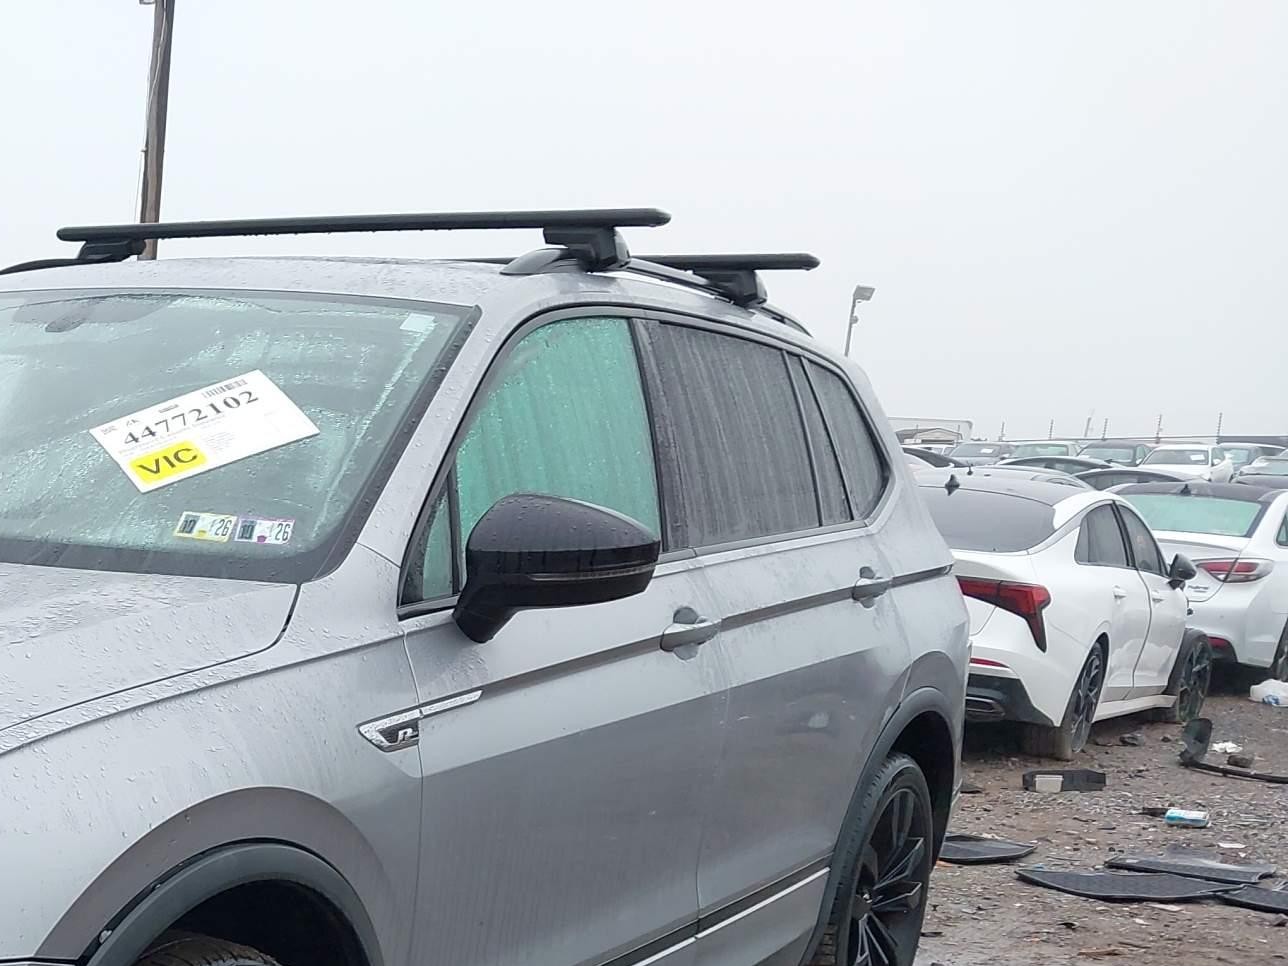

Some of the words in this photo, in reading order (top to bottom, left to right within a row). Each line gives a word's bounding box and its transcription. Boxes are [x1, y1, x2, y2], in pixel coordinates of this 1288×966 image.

[123, 390, 259, 446] 44772102
[137, 447, 199, 475] VIC
[214, 518, 232, 536] 26
[274, 522, 291, 541] 26
